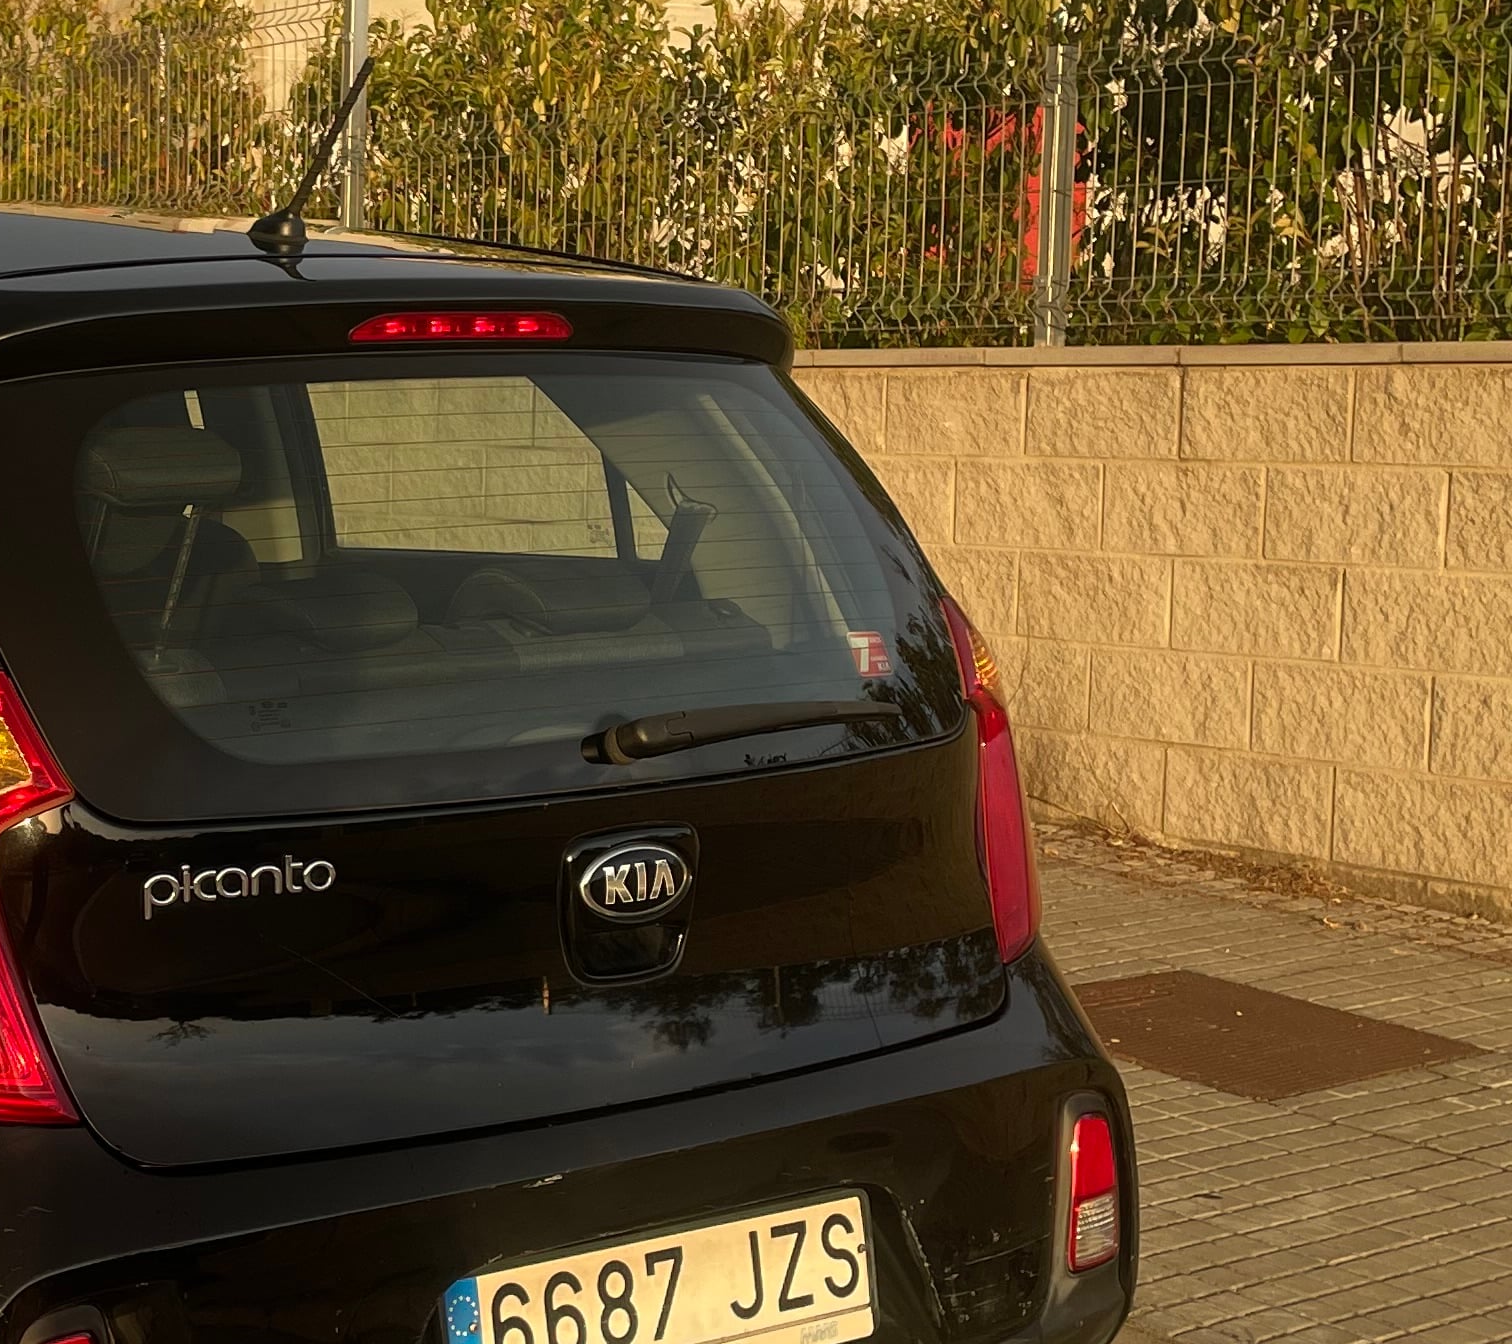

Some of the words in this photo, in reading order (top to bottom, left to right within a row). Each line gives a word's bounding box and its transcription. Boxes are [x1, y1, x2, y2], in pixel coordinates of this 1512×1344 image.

[144, 854, 336, 921] picanto
[602, 859, 675, 905] KIA
[730, 1213, 860, 1320] JZS
